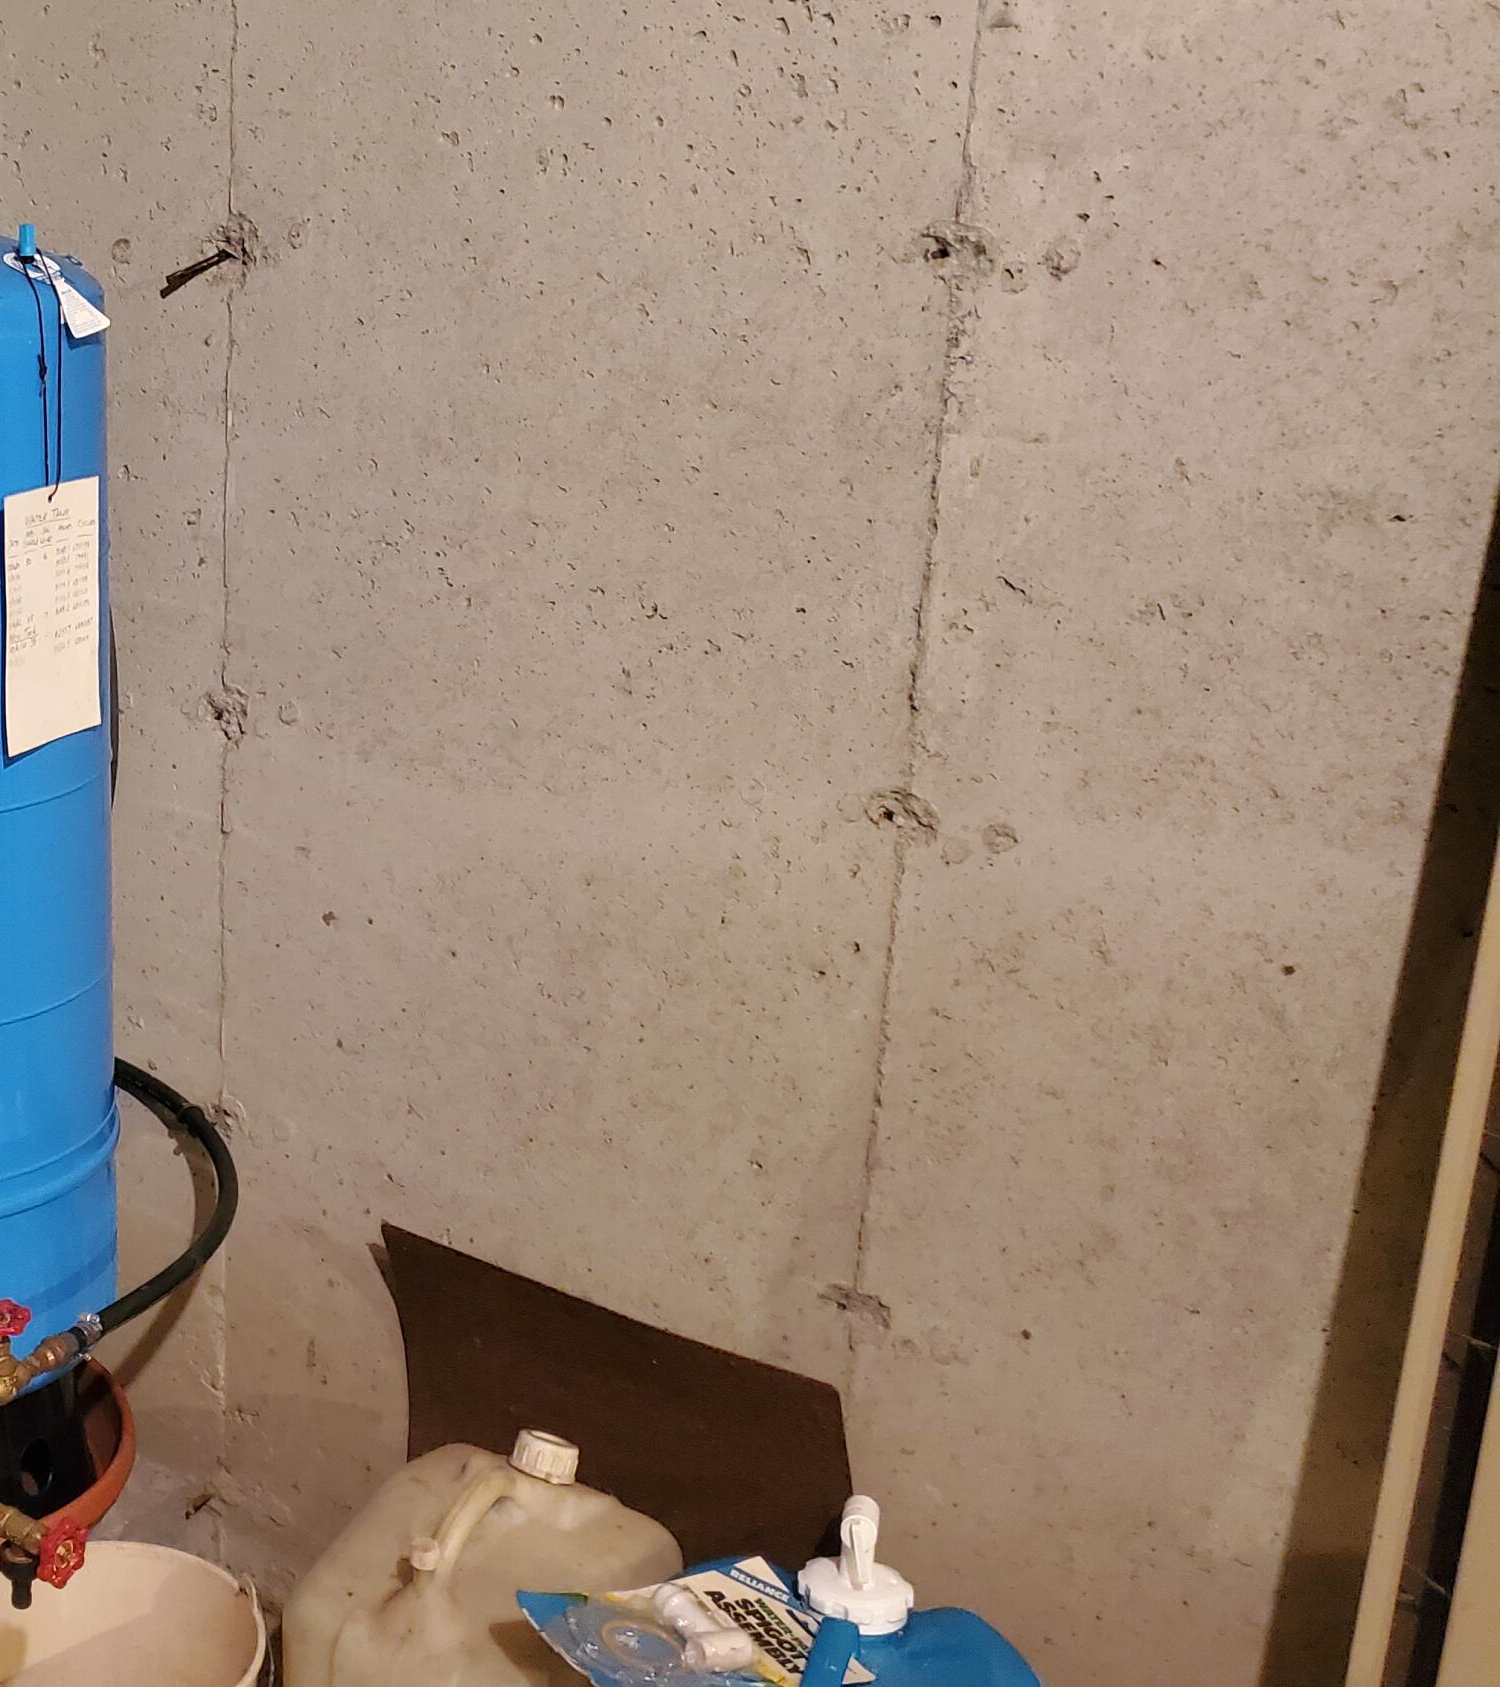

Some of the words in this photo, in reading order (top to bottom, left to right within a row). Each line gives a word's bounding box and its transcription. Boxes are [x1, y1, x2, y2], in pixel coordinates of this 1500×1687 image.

[730, 1568, 790, 1602] RELIANCE
[703, 1590, 804, 1675] ASSEMBLY
[735, 1597, 808, 1661] SPIGOT
